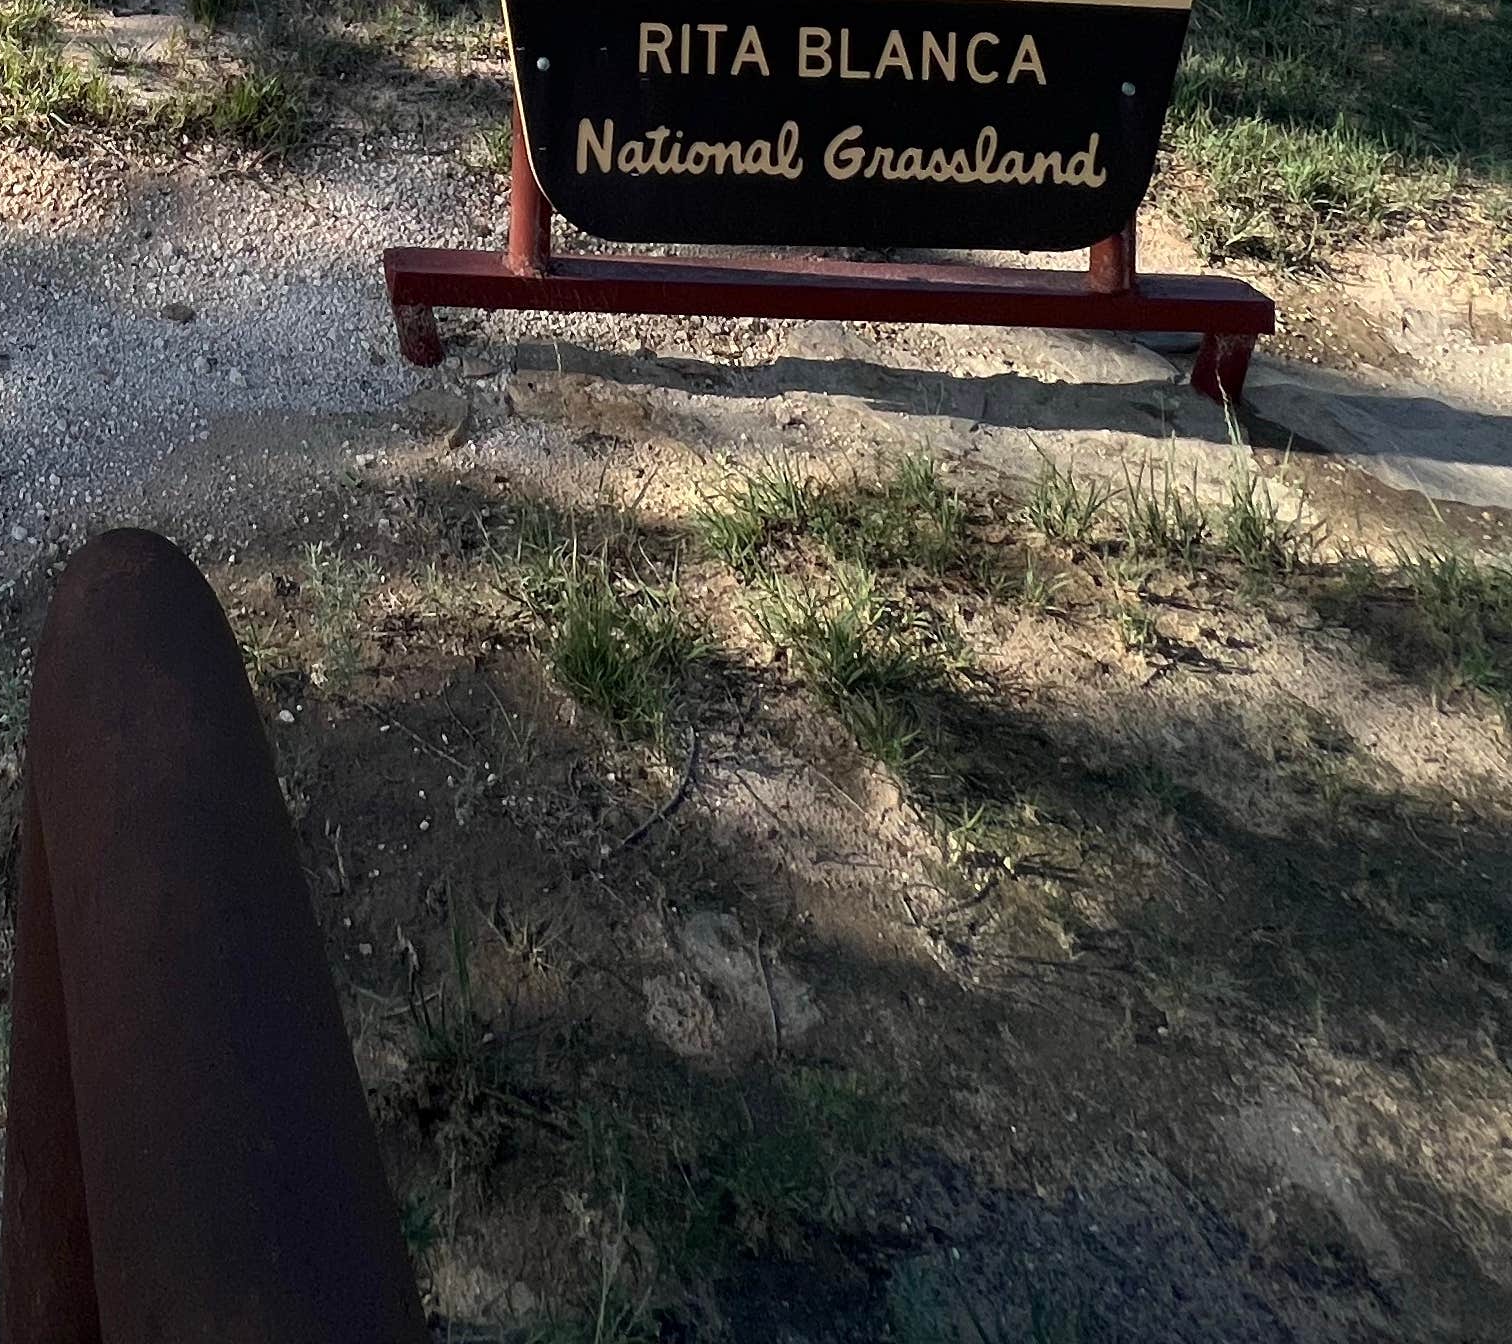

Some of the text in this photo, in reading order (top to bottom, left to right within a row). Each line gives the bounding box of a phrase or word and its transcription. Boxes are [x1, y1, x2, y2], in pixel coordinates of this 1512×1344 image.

[638, 22, 1048, 86] RITA BLANCA
[576, 117, 1107, 188] National Grassland
